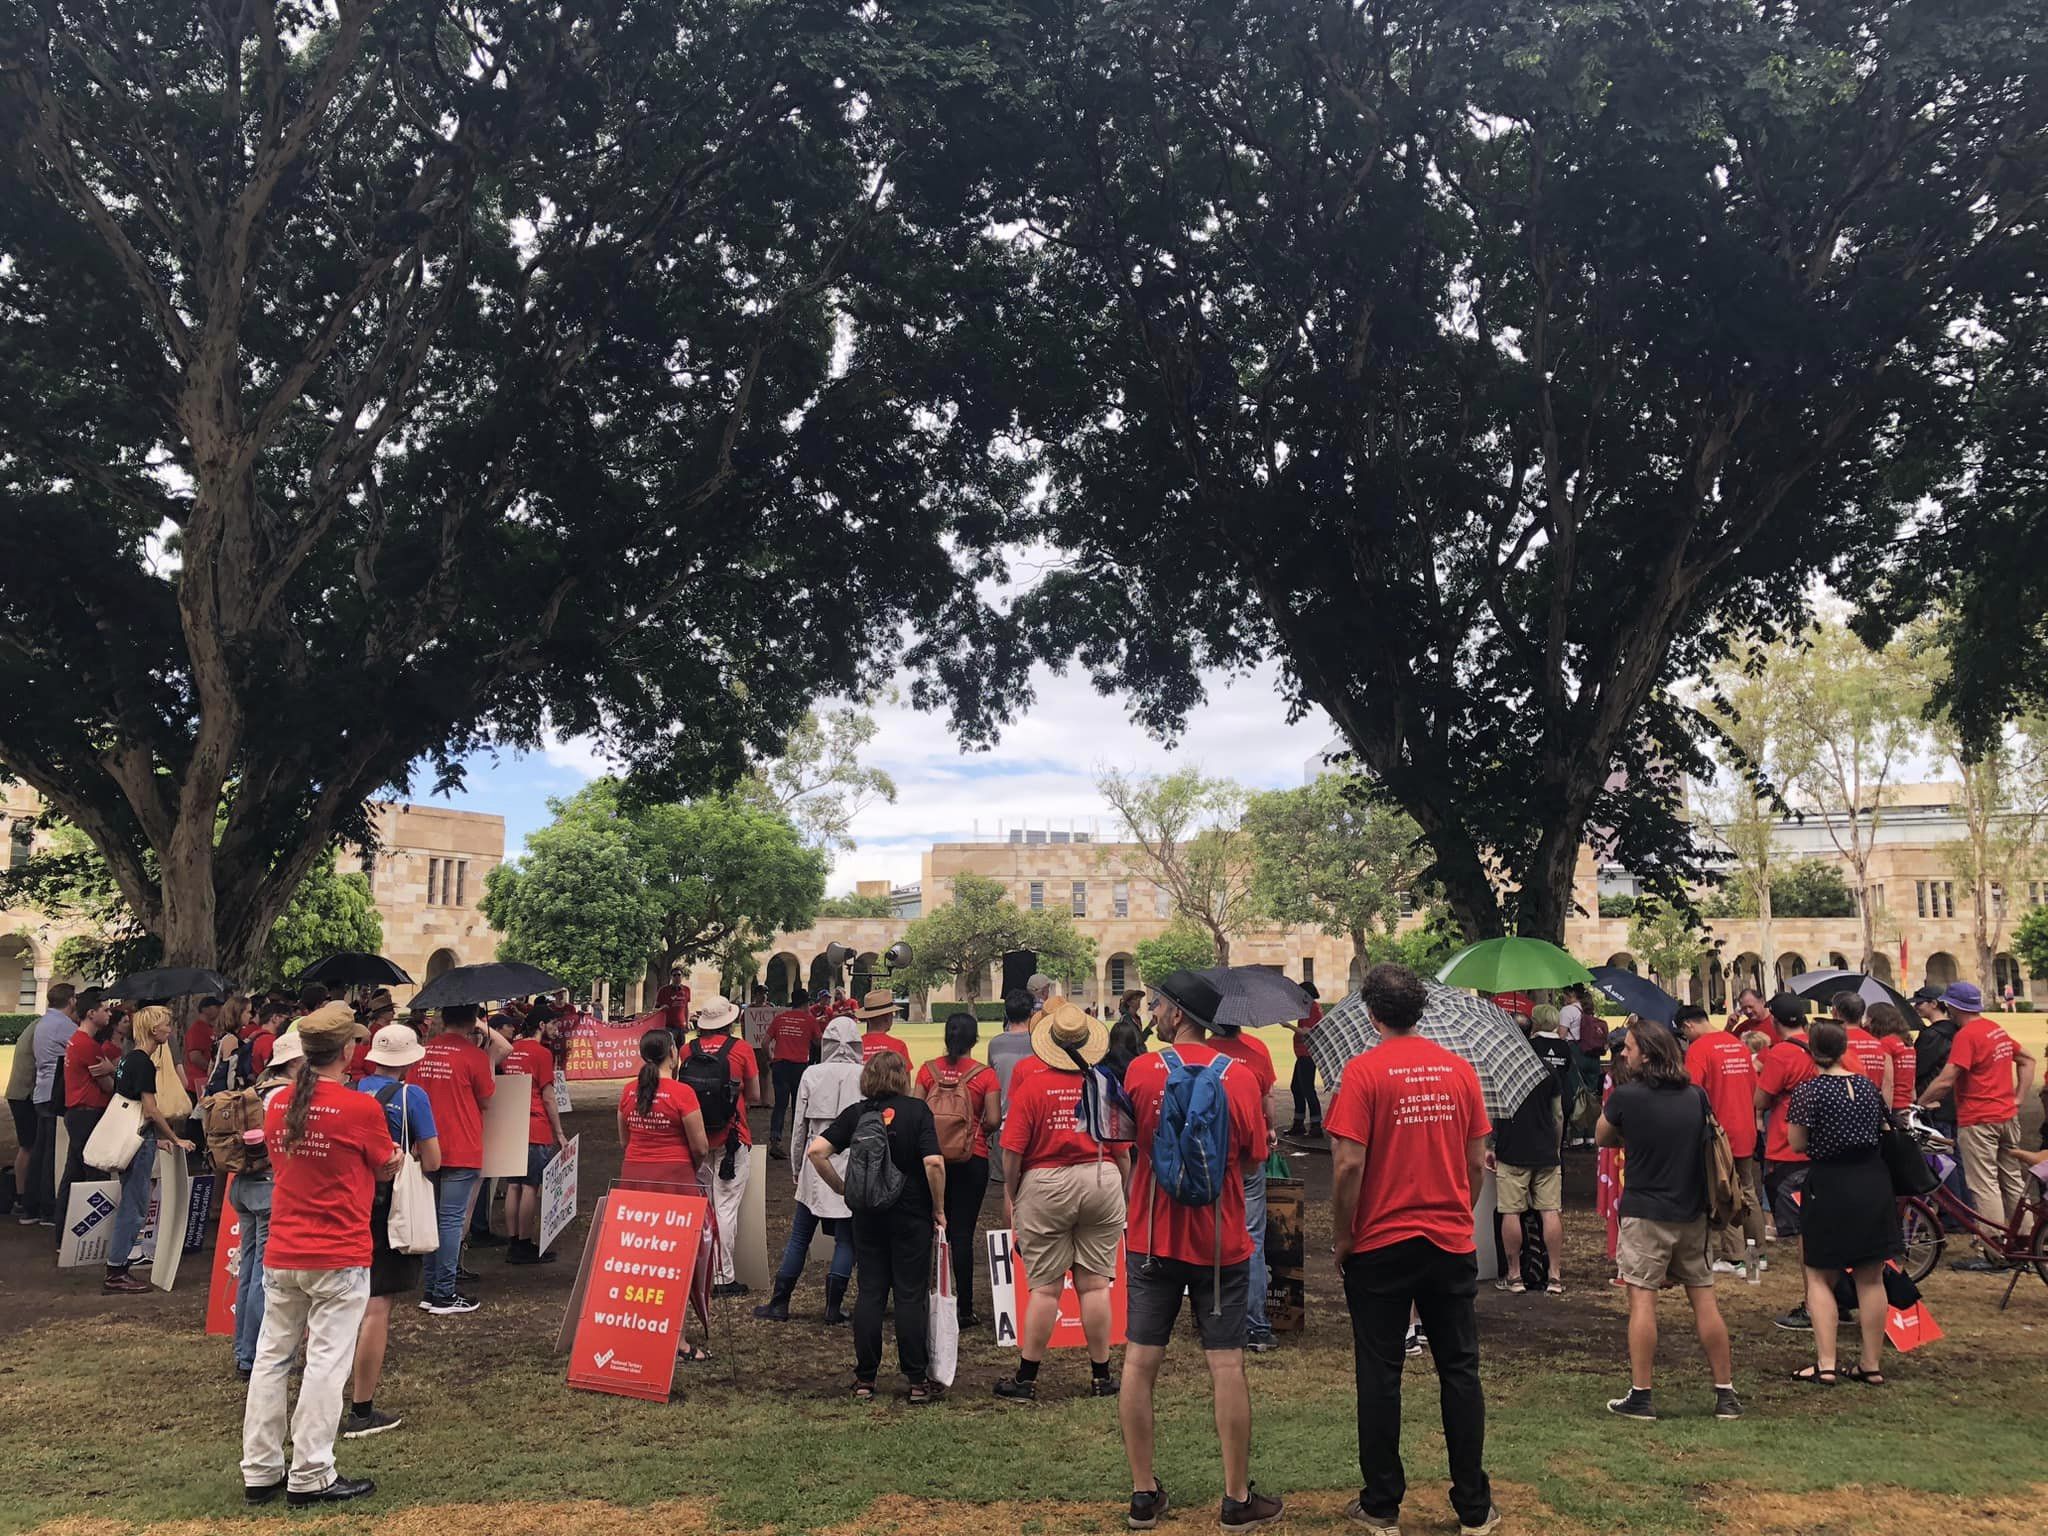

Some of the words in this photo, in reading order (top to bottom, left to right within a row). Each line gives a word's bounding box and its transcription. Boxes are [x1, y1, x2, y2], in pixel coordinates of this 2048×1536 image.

[566, 1038, 592, 1047] REAL
[597, 1040, 618, 1048] pay
[622, 1037, 640, 1046] ris
[566, 1049, 593, 1059] SAFE
[597, 1049, 640, 1058] worklo
[566, 1061, 609, 1071] SECURE
[612, 1062, 633, 1071] job
[1389, 1067, 1411, 1076] Every
[1413, 1065, 1425, 1073] uni
[1427, 1065, 1453, 1073] worker
[1405, 1075, 1441, 1084] deserves:
[1408, 1093, 1435, 1103] SECURE
[1437, 1093, 1450, 1102] job
[310, 1106, 341, 1114] worker
[1401, 1105, 1419, 1114] SAFE
[1422, 1103, 1456, 1112] workload
[1404, 1115, 1423, 1124] REAL
[1423, 1115, 1438, 1123] pay
[301, 1141, 330, 1149] rkload
[185, 1211, 200, 1248] Protecting
[193, 1192, 202, 1211] staff
[617, 1205, 660, 1227] Every
[665, 1210, 693, 1227] Uni
[193, 1223, 205, 1246] higher
[621, 1231, 677, 1252] Worker
[604, 1256, 681, 1280] deserves:
[609, 1286, 619, 1299] a
[624, 1285, 665, 1305] SAFE
[595, 1311, 669, 1334] workload
